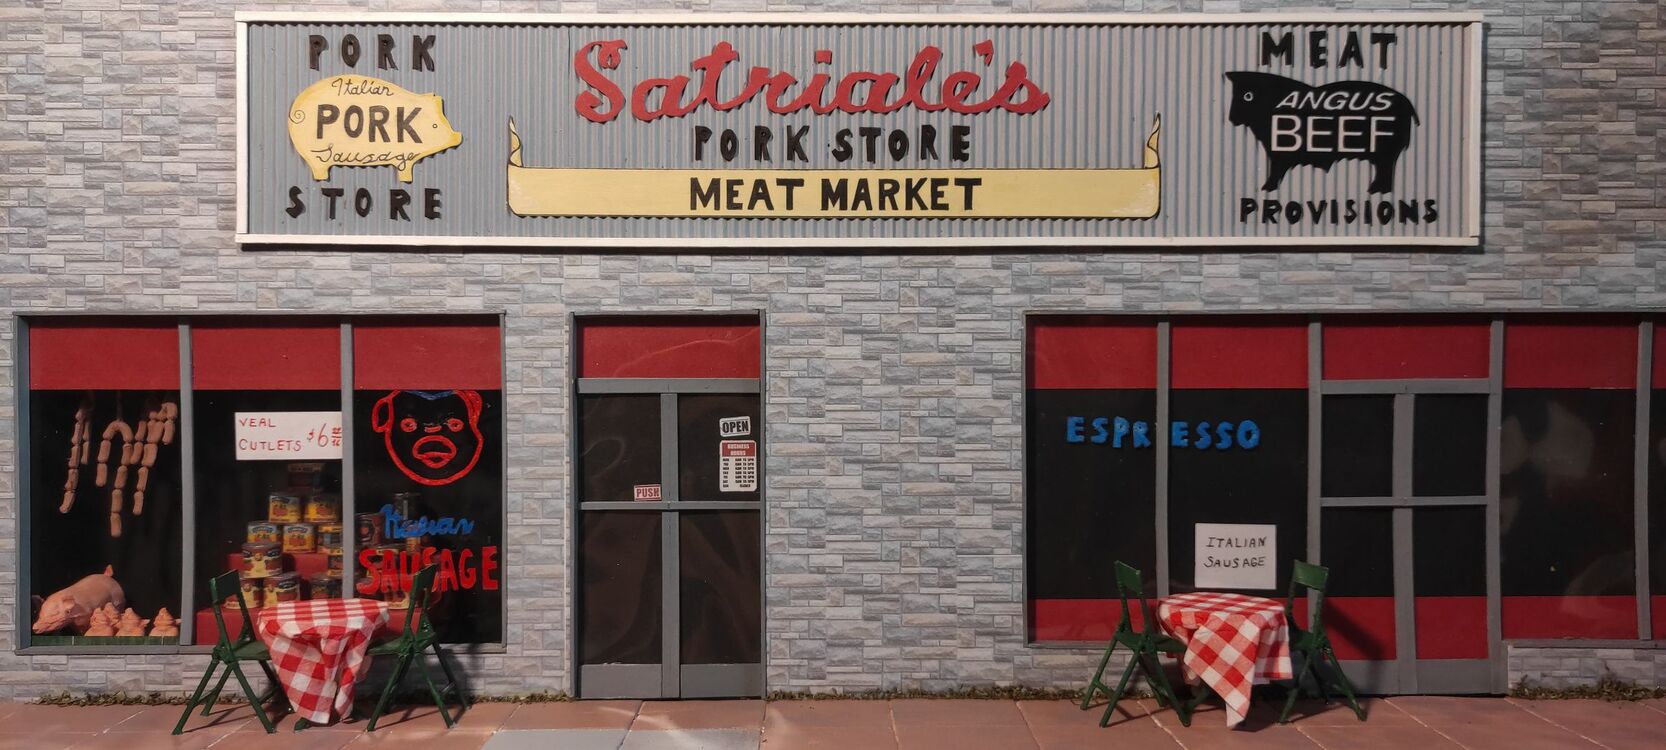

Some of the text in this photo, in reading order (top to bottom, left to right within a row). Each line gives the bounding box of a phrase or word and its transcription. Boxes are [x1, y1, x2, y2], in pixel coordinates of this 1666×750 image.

[309, 34, 437, 72] PORK
[1261, 30, 1398, 69] MEAT
[331, 77, 394, 96] Italian
[573, 38, 1052, 123] Satriale's
[1275, 91, 1395, 111] ANGUS
[316, 104, 423, 143] PORK
[1271, 114, 1396, 153] BEEF
[694, 123, 972, 162] PORK STORE
[286, 186, 442, 222] STORE
[689, 177, 983, 211] MEAT MARKET
[1240, 197, 1439, 226] PROVISIONS
[239, 418, 277, 428] VEAL
[722, 420, 749, 433] OPEN
[1066, 416, 1261, 450] ESPRESSO
[239, 438, 302, 452] CUTLETS
[636, 487, 660, 498] PUSH
[1205, 536, 1267, 548] ITALIAN
[1203, 556, 1266, 569] SAUSAGE
